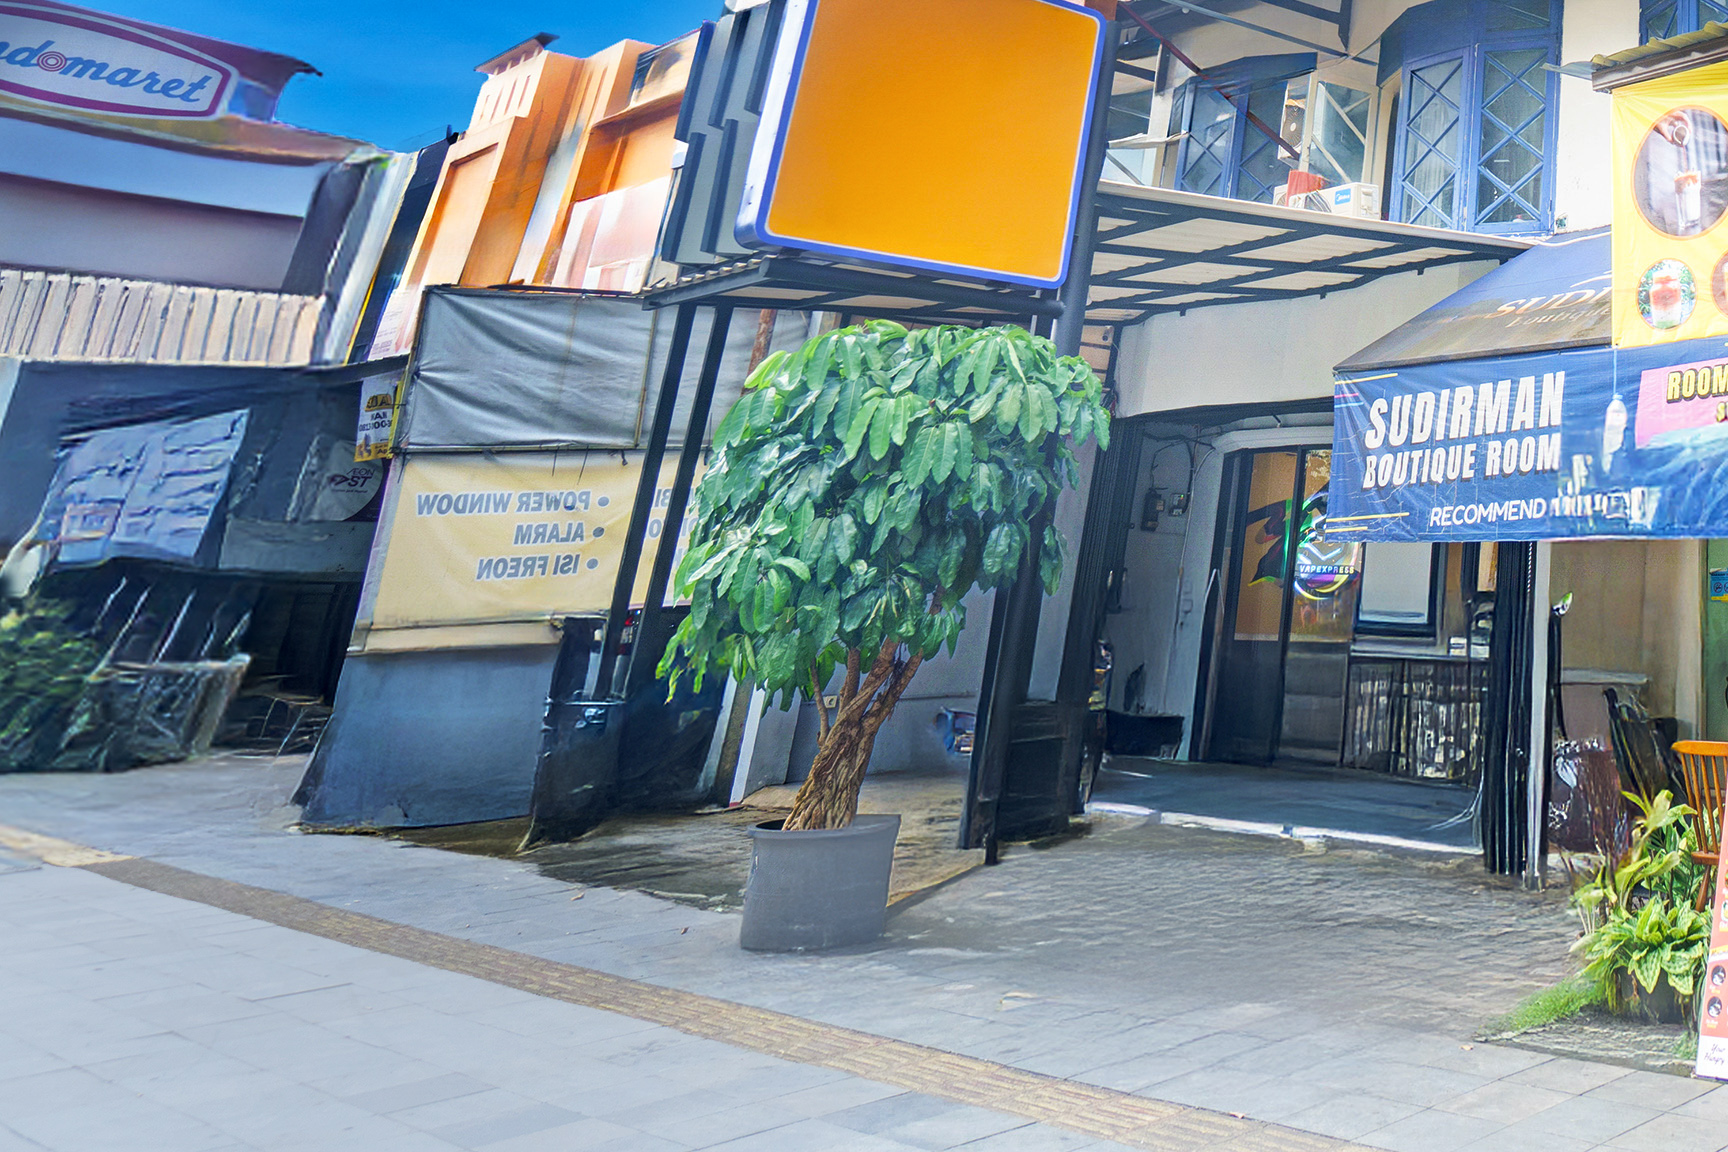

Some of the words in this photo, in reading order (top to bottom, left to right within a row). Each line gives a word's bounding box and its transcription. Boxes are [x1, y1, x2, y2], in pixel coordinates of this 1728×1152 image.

[1364, 371, 1566, 450] SUDIRMAN
[1361, 443, 1477, 490] BOUTIQUE
[1484, 433, 1562, 477] ROOM
[1300, 564, 1355, 574] VAPEXPRESS
